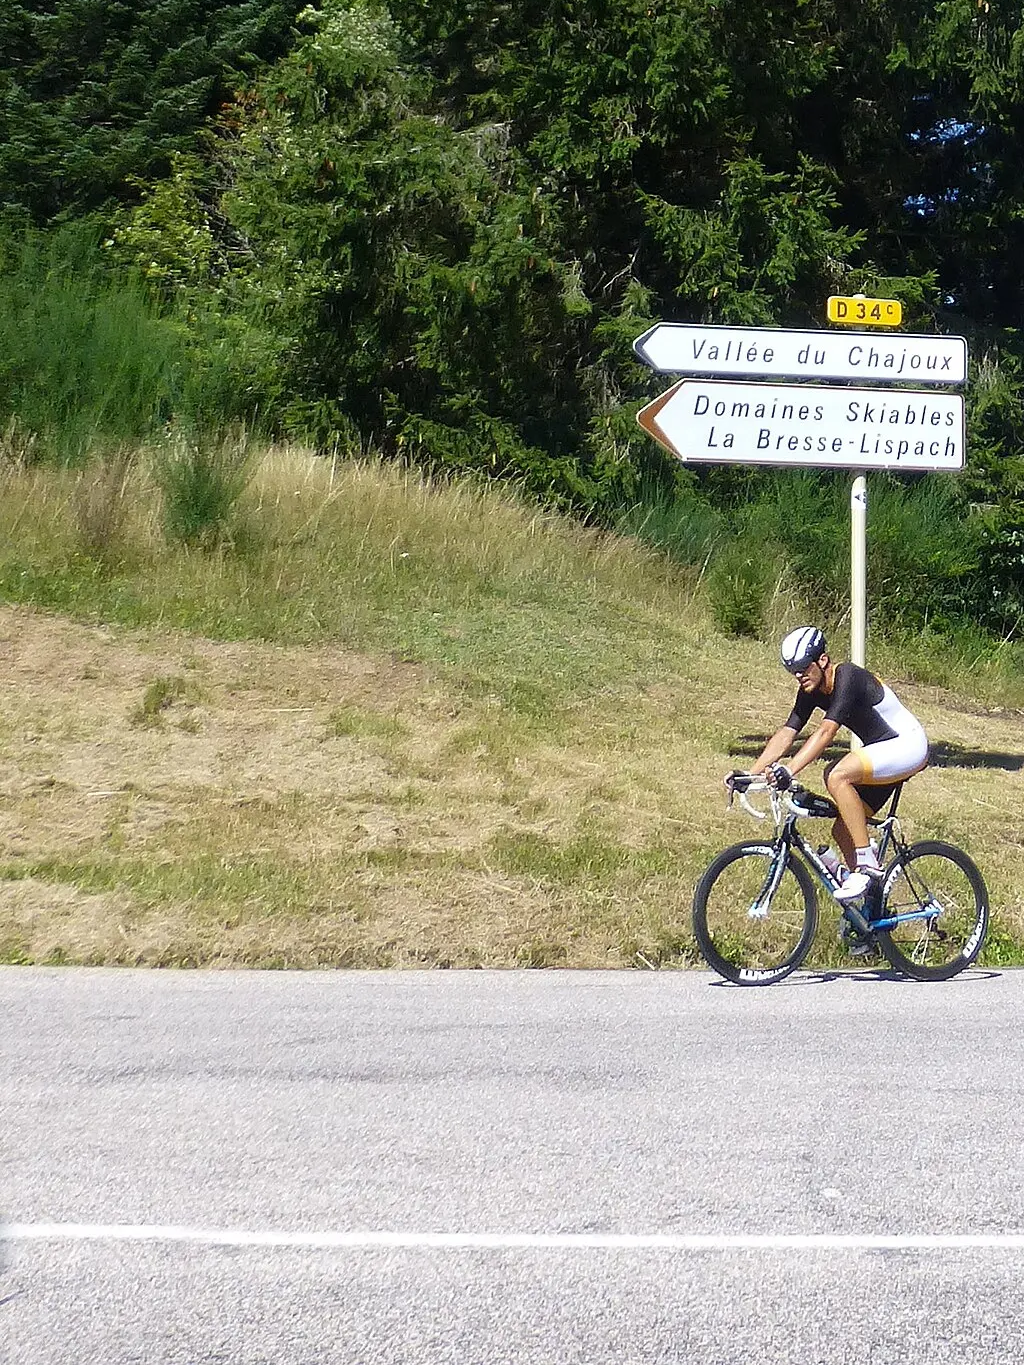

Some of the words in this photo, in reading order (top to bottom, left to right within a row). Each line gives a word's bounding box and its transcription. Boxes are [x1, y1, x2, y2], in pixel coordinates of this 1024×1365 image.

[836, 303, 848, 319] D
[692, 338, 775, 363] Vallée
[797, 343, 826, 365] du
[847, 345, 953, 373] Chajoux
[693, 394, 824, 421] Domaines
[846, 401, 955, 426] Skiables
[707, 427, 734, 448] La
[756, 429, 956, 460] Bresse-Lispach
